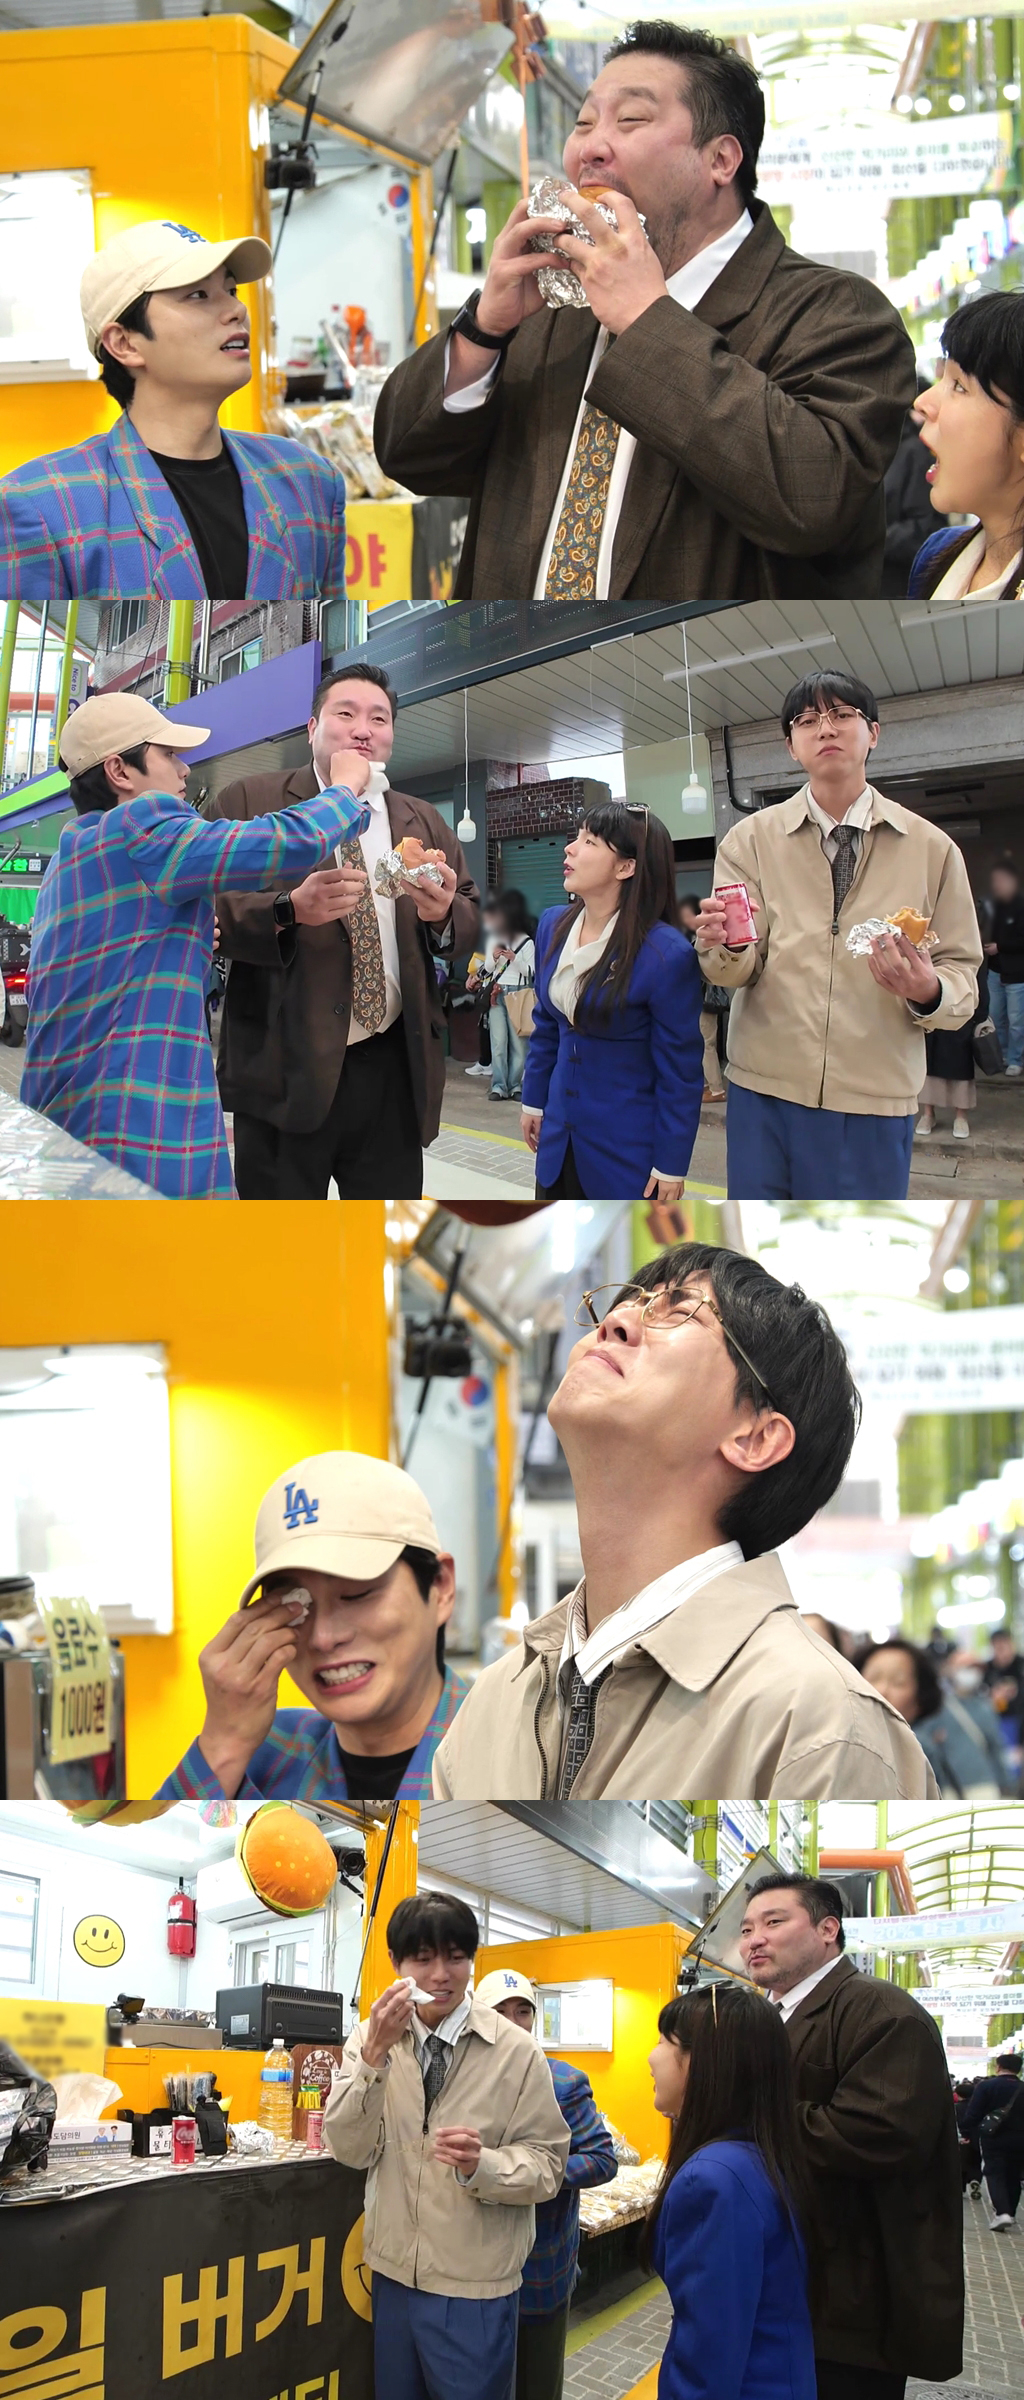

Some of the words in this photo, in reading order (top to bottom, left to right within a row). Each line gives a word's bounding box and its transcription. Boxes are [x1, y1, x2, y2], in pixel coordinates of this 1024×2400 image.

[283, 1481, 319, 1530] LA
[52, 1617, 99, 1672] 음료수
[60, 1680, 106, 1739] 1000원
[503, 1974, 518, 1988] LA
[310, 2074, 331, 2086] Coffee
[53, 2131, 81, 2140] 도담의원
[162, 2236, 327, 2380] 버거
